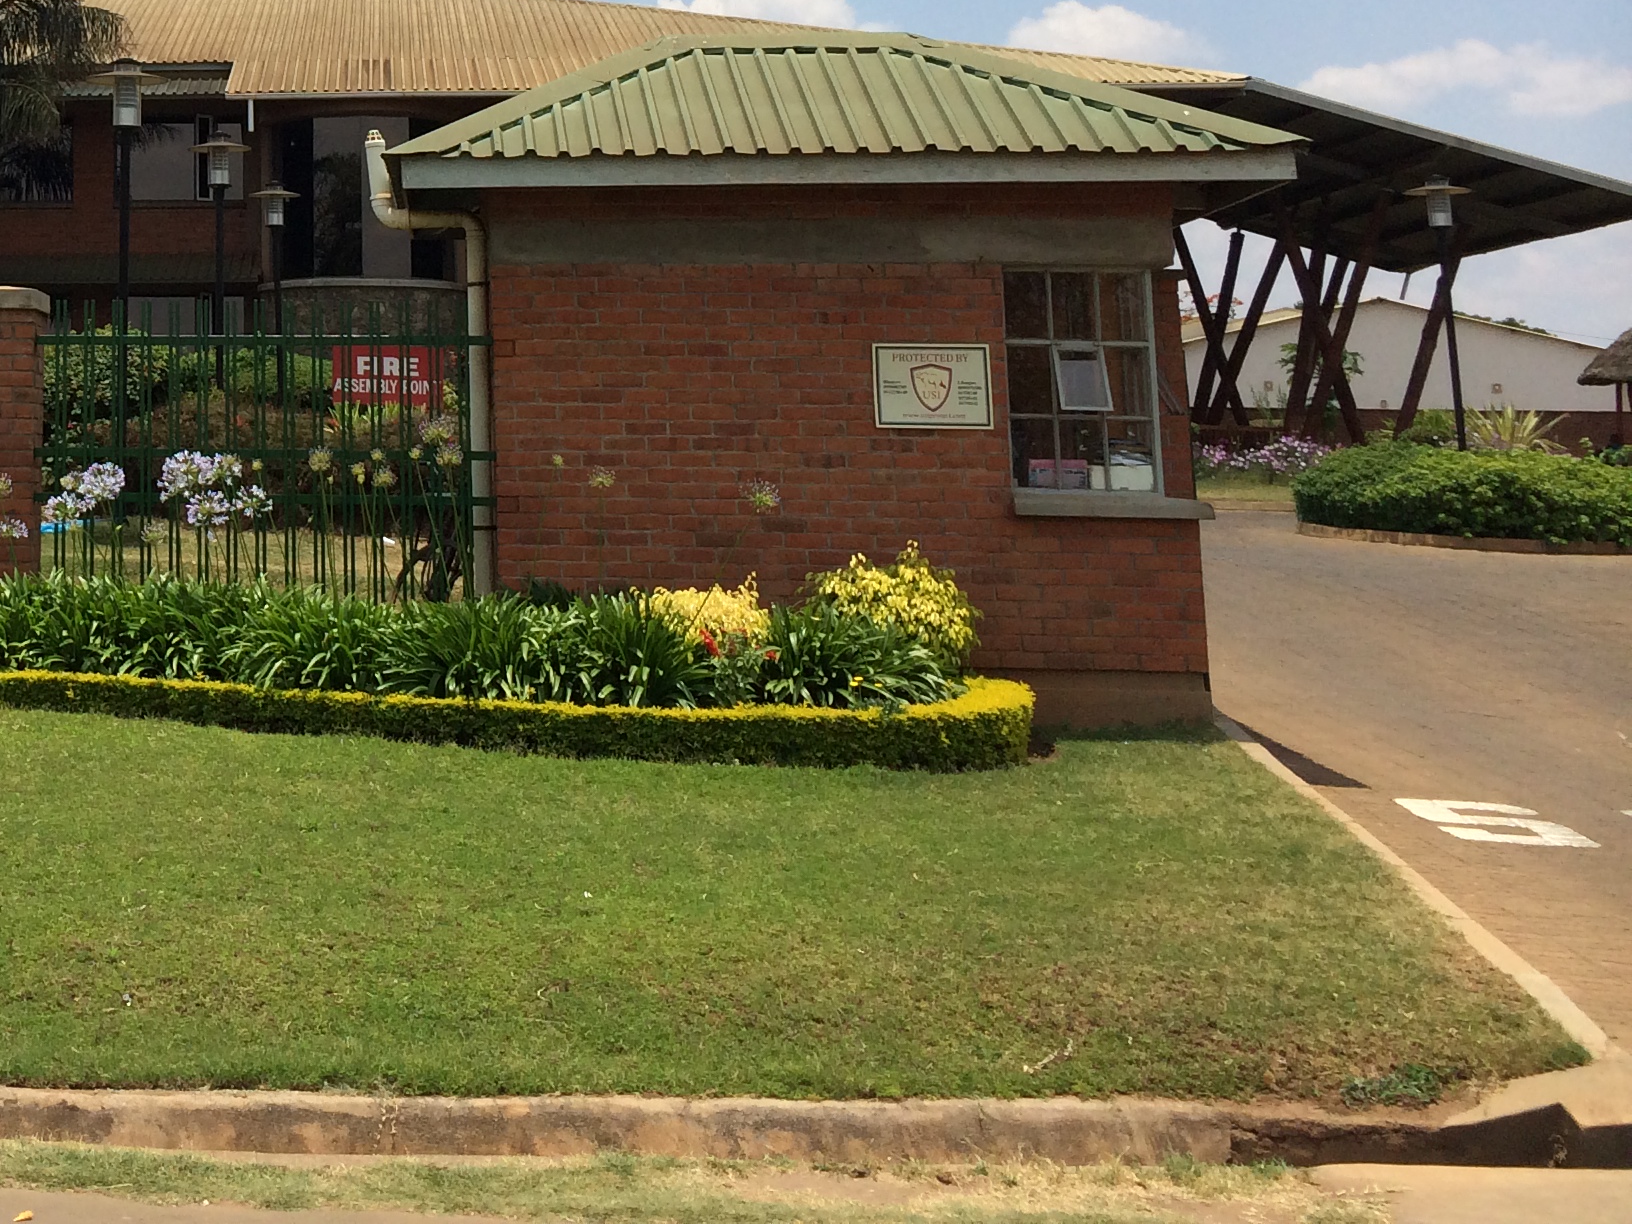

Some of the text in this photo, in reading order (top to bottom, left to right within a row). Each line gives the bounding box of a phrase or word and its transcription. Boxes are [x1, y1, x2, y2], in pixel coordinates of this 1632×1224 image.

[356, 355, 420, 377] FIRE
[891, 353, 969, 363] PROTECTED BY
